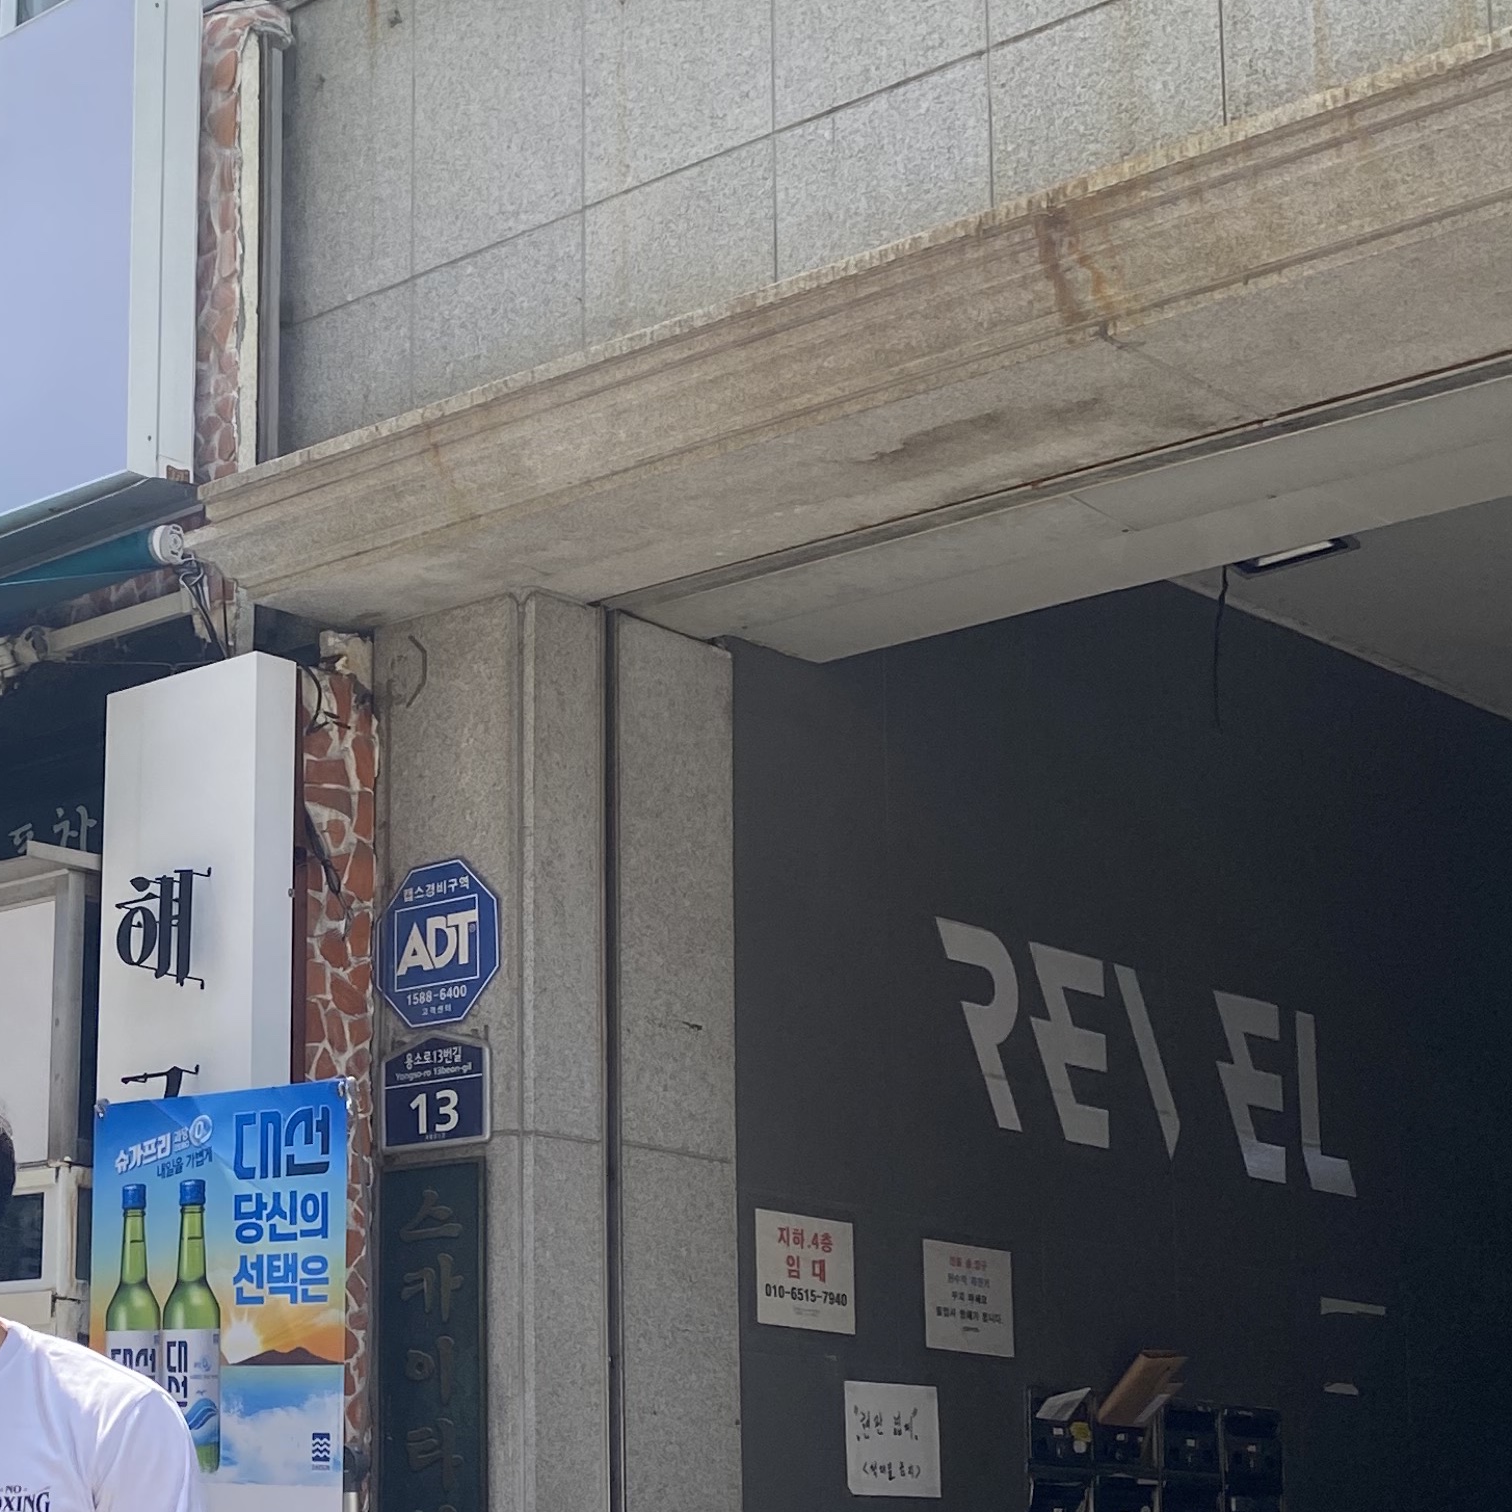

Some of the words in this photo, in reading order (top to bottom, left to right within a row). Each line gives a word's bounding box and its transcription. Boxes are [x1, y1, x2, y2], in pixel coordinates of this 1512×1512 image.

[397, 909, 478, 976] ADT
[406, 984, 468, 1006] 1588-6400
[404, 1047, 463, 1070] 용소로13번길
[409, 1089, 460, 1135] 13
[114, 1130, 172, 1175] 슈가프리
[233, 1106, 331, 1181] 대선
[156, 1157, 183, 1180] 내일을
[233, 1191, 330, 1245] 당신의
[232, 1251, 331, 1306] 선택은
[764, 1282, 848, 1308] 010-6515-7940
[5, 1485, 22, 1494] NO
